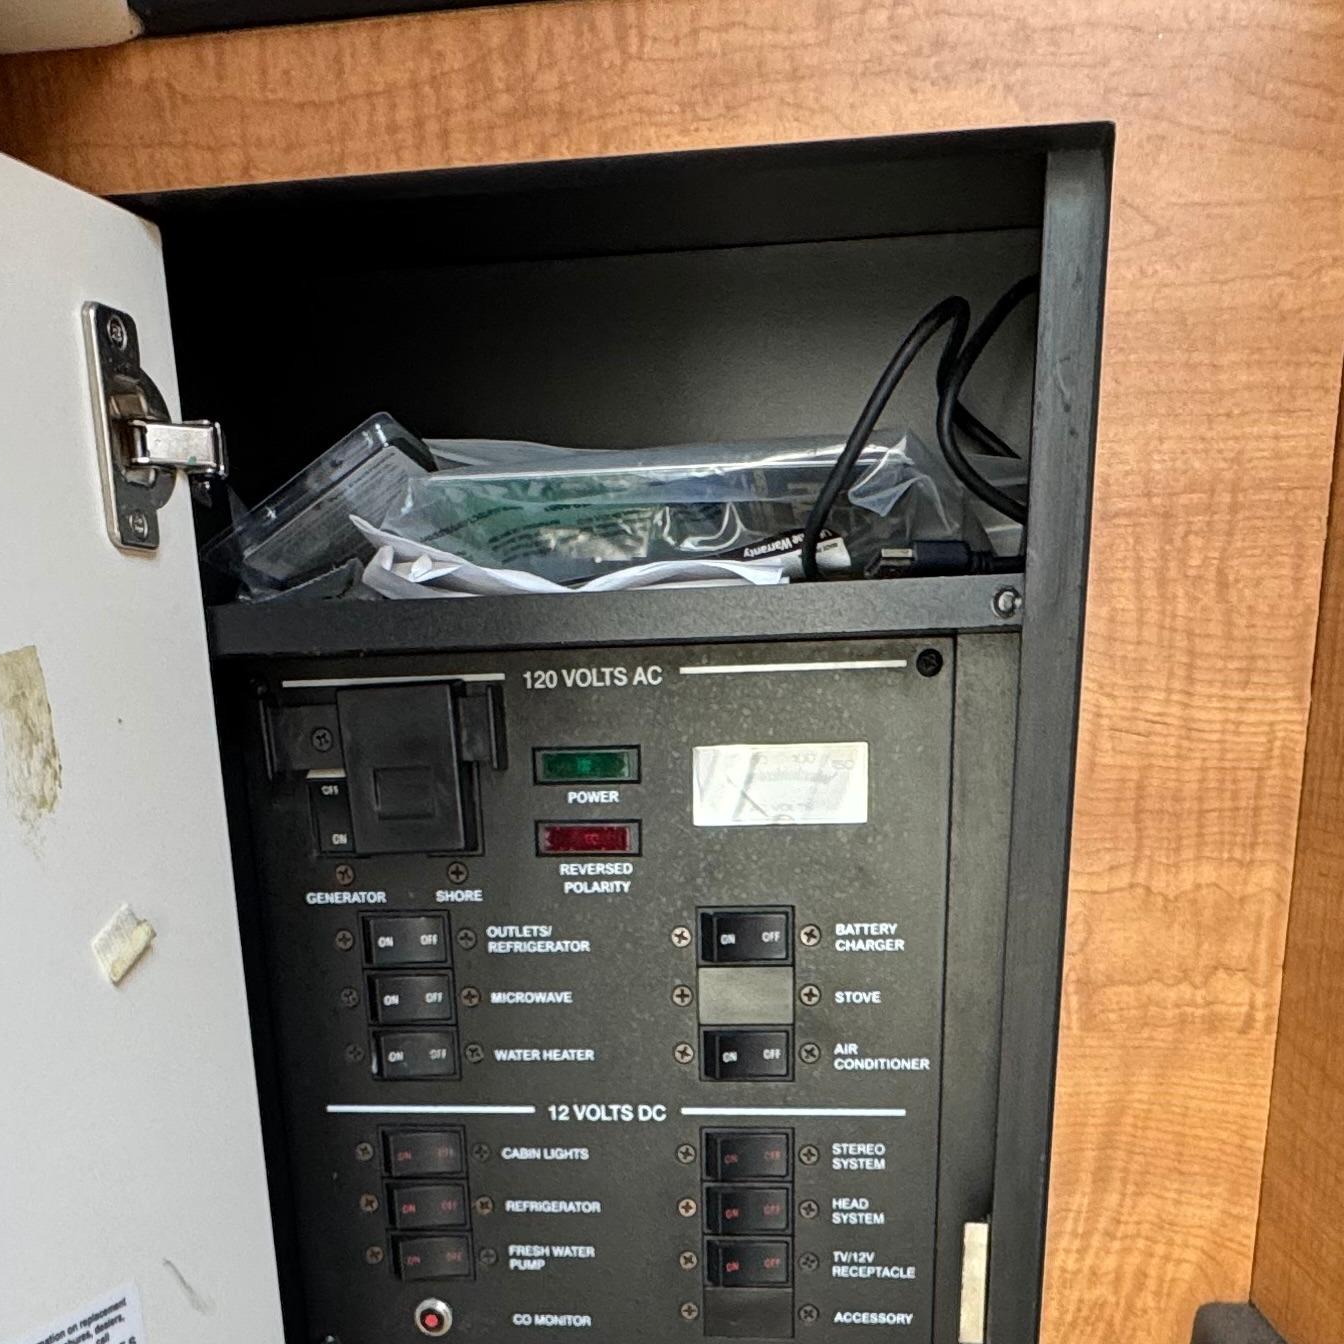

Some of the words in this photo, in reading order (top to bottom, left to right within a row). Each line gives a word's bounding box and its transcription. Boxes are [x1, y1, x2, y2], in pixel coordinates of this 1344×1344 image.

[522, 670, 558, 690] 120
[561, 666, 629, 688] VOLTS
[632, 665, 664, 686] AC
[567, 790, 620, 804] POWER
[331, 833, 348, 845] ON
[559, 862, 634, 876] REVERSED
[564, 880, 632, 894] POLARITY
[306, 890, 387, 905] GENERATOR
[435, 889, 484, 902] SHORE
[486, 925, 553, 938] OUTLETS/
[835, 923, 898, 936] BATTERY
[377, 936, 394, 948] ON
[420, 934, 439, 946] OFF
[720, 933, 736, 945] ON
[761, 931, 781, 942] OFF
[835, 938, 905, 951] CHARGER
[487, 940, 591, 953] REFRIGERATOR
[383, 994, 400, 1006] ON
[425, 992, 443, 1003] OFF
[490, 991, 574, 1004] MICROWAVE
[834, 990, 882, 1004] STOVE
[388, 1050, 404, 1062] ON
[429, 1048, 447, 1060] OFF
[494, 1049, 542, 1062] WATER
[542, 1049, 595, 1062] HEATER
[722, 1051, 738, 1063] ON
[763, 1048, 782, 1060] OFF
[833, 1043, 859, 1056] AIR
[833, 1057, 931, 1071] CONDITIONER
[547, 1104, 571, 1121] 12
[572, 1103, 634, 1122] VOLTS
[637, 1103, 667, 1122] DC
[501, 1147, 542, 1160] CABIN
[543, 1147, 590, 1160] LIGHTS
[831, 1142, 886, 1156] STEREO
[831, 1158, 886, 1170] SYSTEM
[402, 1203, 416, 1215] ON
[505, 1200, 602, 1214] REFRIGERATOR
[832, 1198, 870, 1210] HEAD
[831, 1212, 885, 1225] SYSTEM
[508, 1244, 550, 1257] FRESH
[550, 1245, 595, 1259] WATER
[832, 1251, 875, 1263] TV/12V
[509, 1258, 546, 1271] PUMP
[831, 1266, 916, 1280] RECEPTACLE
[67, 1323, 79, 1335] on
[80, 1297, 127, 1331] replacement
[512, 1313, 532, 1326] CO
[534, 1314, 592, 1328] MONITOR
[833, 1311, 914, 1325] ACCESSORY
[94, 1313, 126, 1335] dealers,
